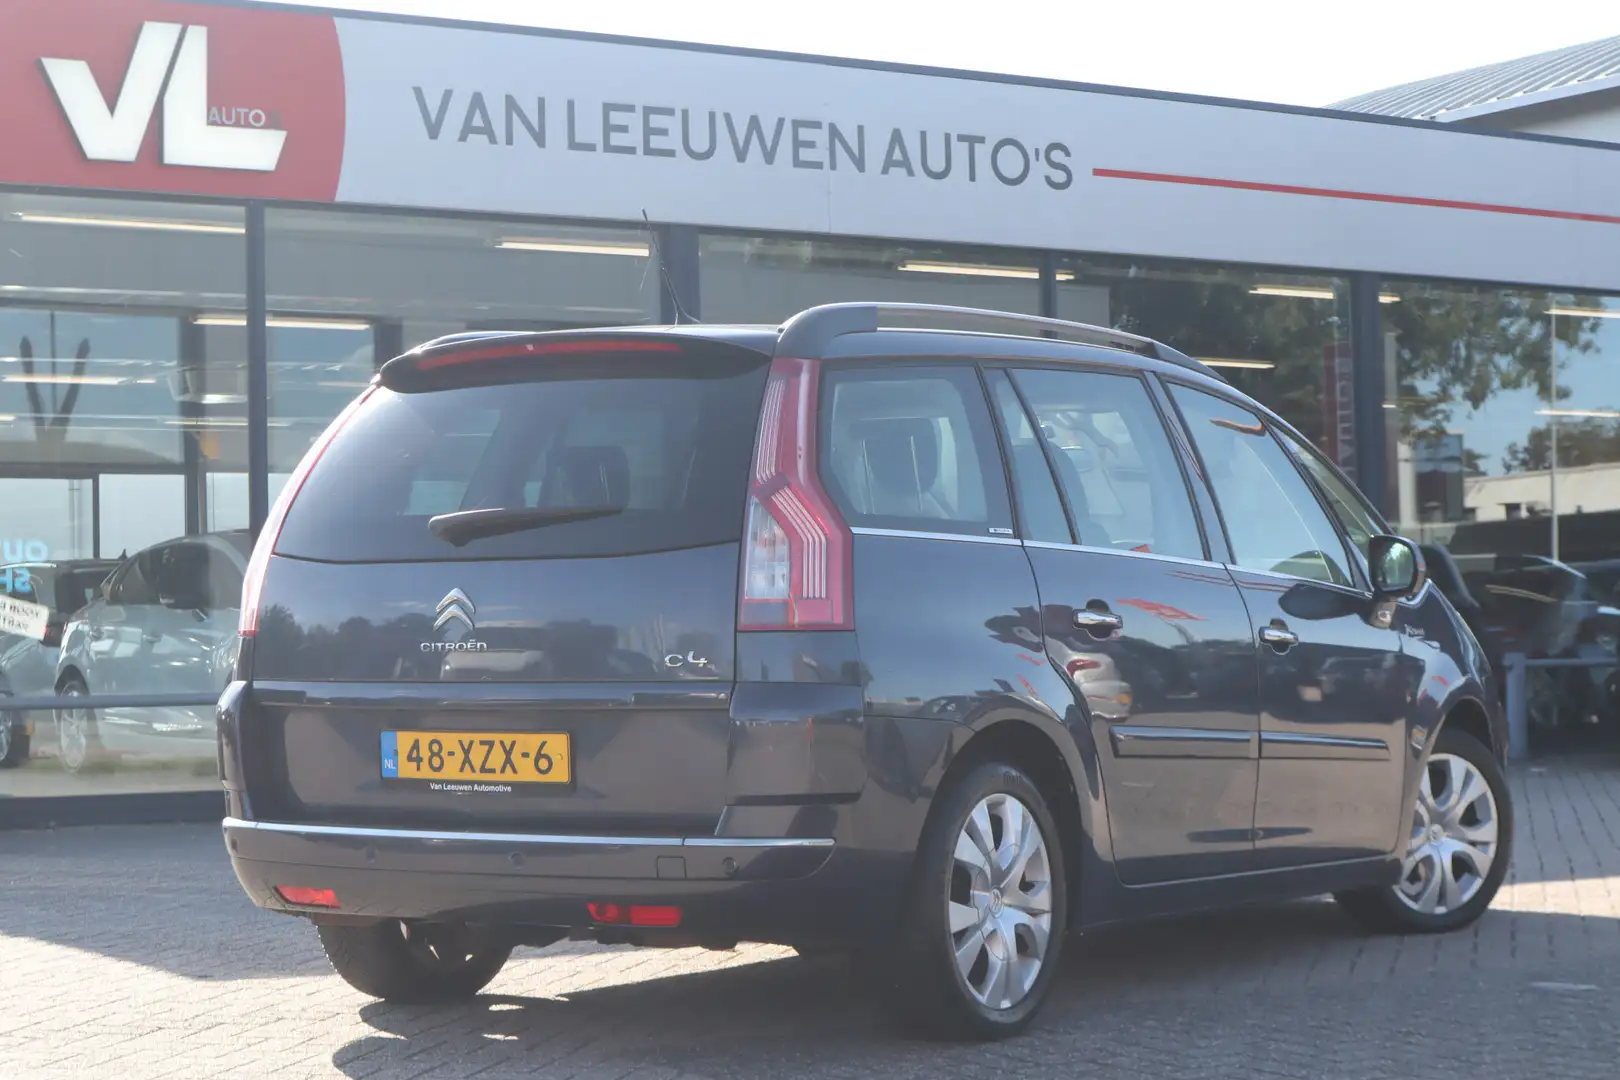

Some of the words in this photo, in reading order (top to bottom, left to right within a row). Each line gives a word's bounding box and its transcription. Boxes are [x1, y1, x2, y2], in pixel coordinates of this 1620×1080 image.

[38, 20, 288, 171] VL
[411, 86, 547, 149] VAN
[566, 98, 866, 174] LEEUWEN
[880, 127, 1073, 190] AUTO'S
[420, 639, 488, 653] CITROËN
[664, 650, 708, 668] C4
[384, 758, 397, 770] NL
[406, 738, 554, 776] 48-XZX-6
[429, 782, 442, 791] Van
[443, 782, 473, 792] Leeuwen
[473, 783, 512, 793] Automotive
